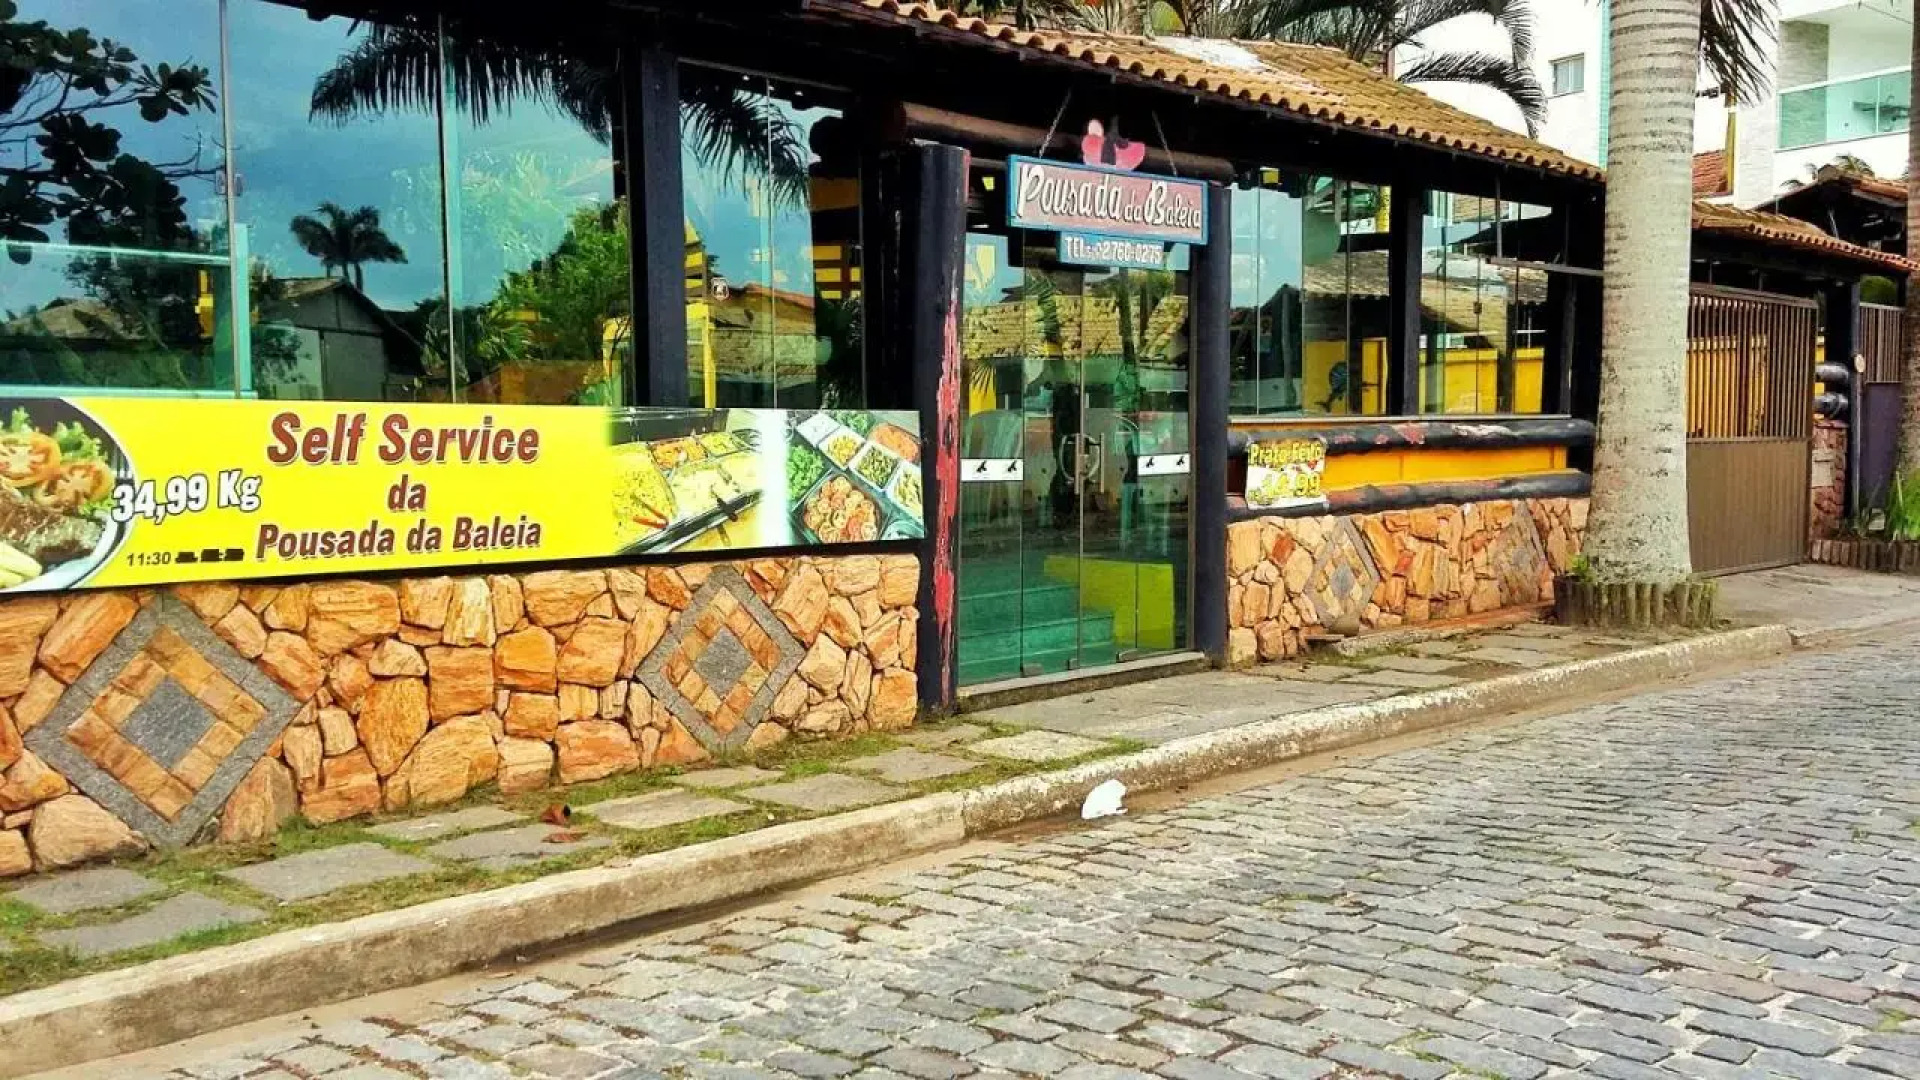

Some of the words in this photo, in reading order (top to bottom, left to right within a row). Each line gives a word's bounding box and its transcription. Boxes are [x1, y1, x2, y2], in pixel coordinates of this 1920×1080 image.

[1016, 163, 1122, 221] Pousada
[1124, 192, 1143, 221] da
[1144, 179, 1201, 229] Baleia
[267, 412, 367, 464] Self
[378, 413, 540, 463] Service
[1249, 443, 1287, 467] Prato
[1292, 441, 1323, 463] Feito
[111, 473, 209, 525] 34,99
[217, 468, 263, 512] Kg
[387, 473, 427, 512] da
[127, 551, 171, 566] 11:30
[256, 520, 396, 561] Pousada
[406, 518, 442, 552] da
[452, 514, 542, 550] Baleia
